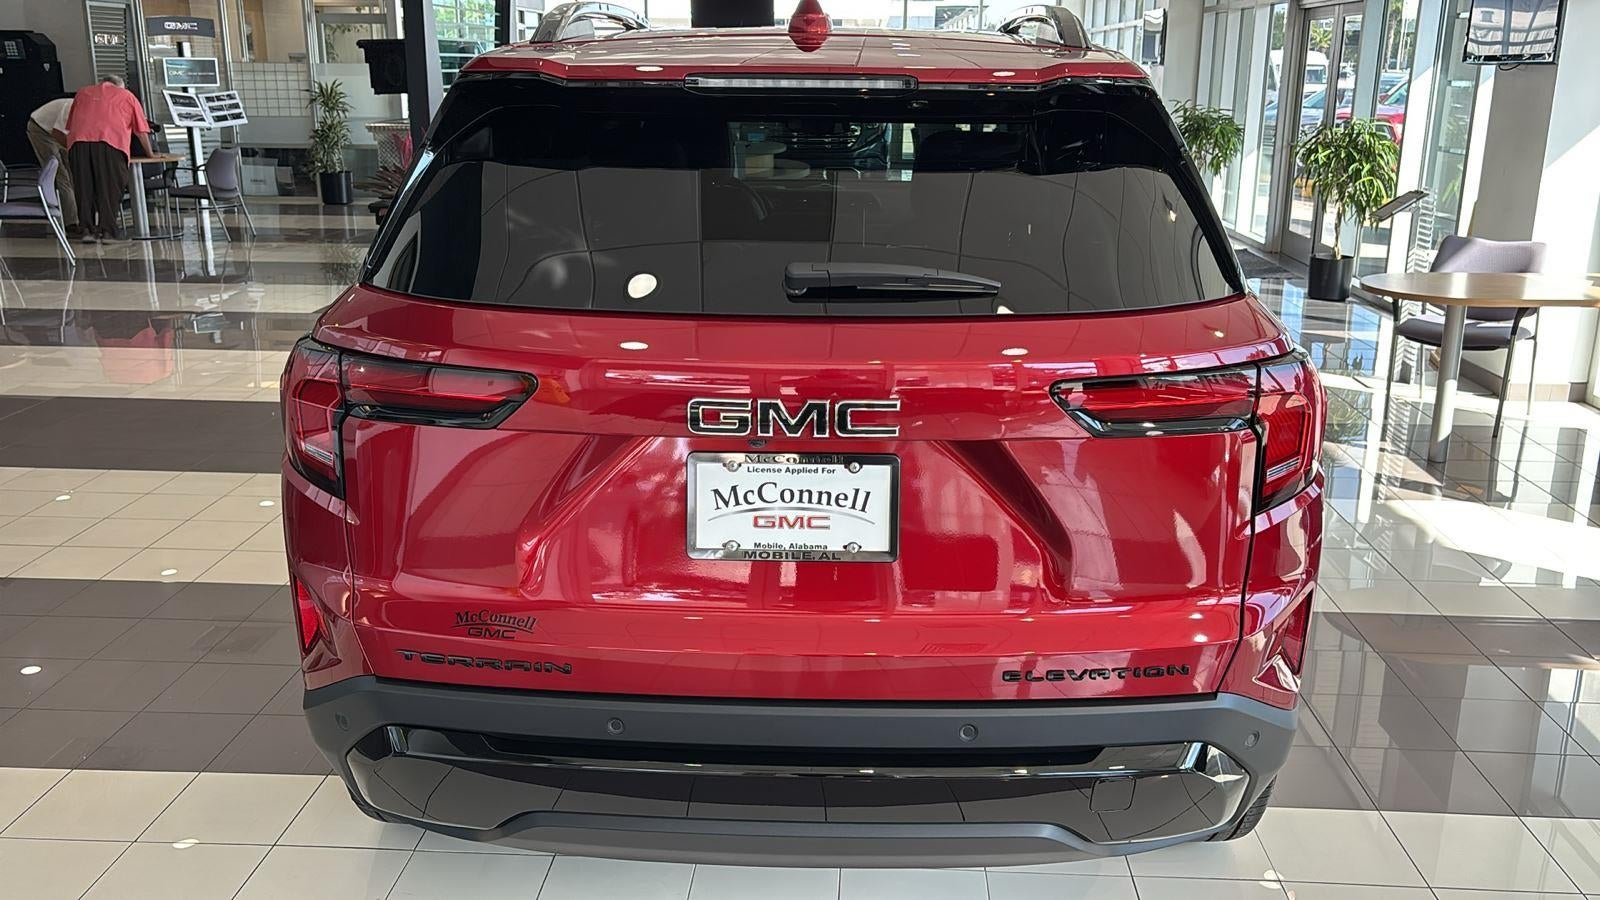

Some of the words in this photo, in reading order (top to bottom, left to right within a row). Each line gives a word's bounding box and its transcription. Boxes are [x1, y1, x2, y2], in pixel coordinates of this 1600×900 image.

[163, 21, 199, 31] GMC
[688, 398, 901, 438] GMC
[747, 466, 783, 474] License
[784, 466, 819, 475] Applied
[821, 467, 837, 475] For
[711, 481, 872, 514] McConnell
[752, 515, 831, 530] GMC
[753, 542, 786, 551] Mobile,
[788, 542, 828, 550] Alabama
[818, 552, 842, 561] AL
[455, 609, 537, 630] McConnell
[467, 627, 516, 640] GMC
[396, 649, 573, 675] TERRAIN
[1002, 664, 1191, 683] ELEVATION
